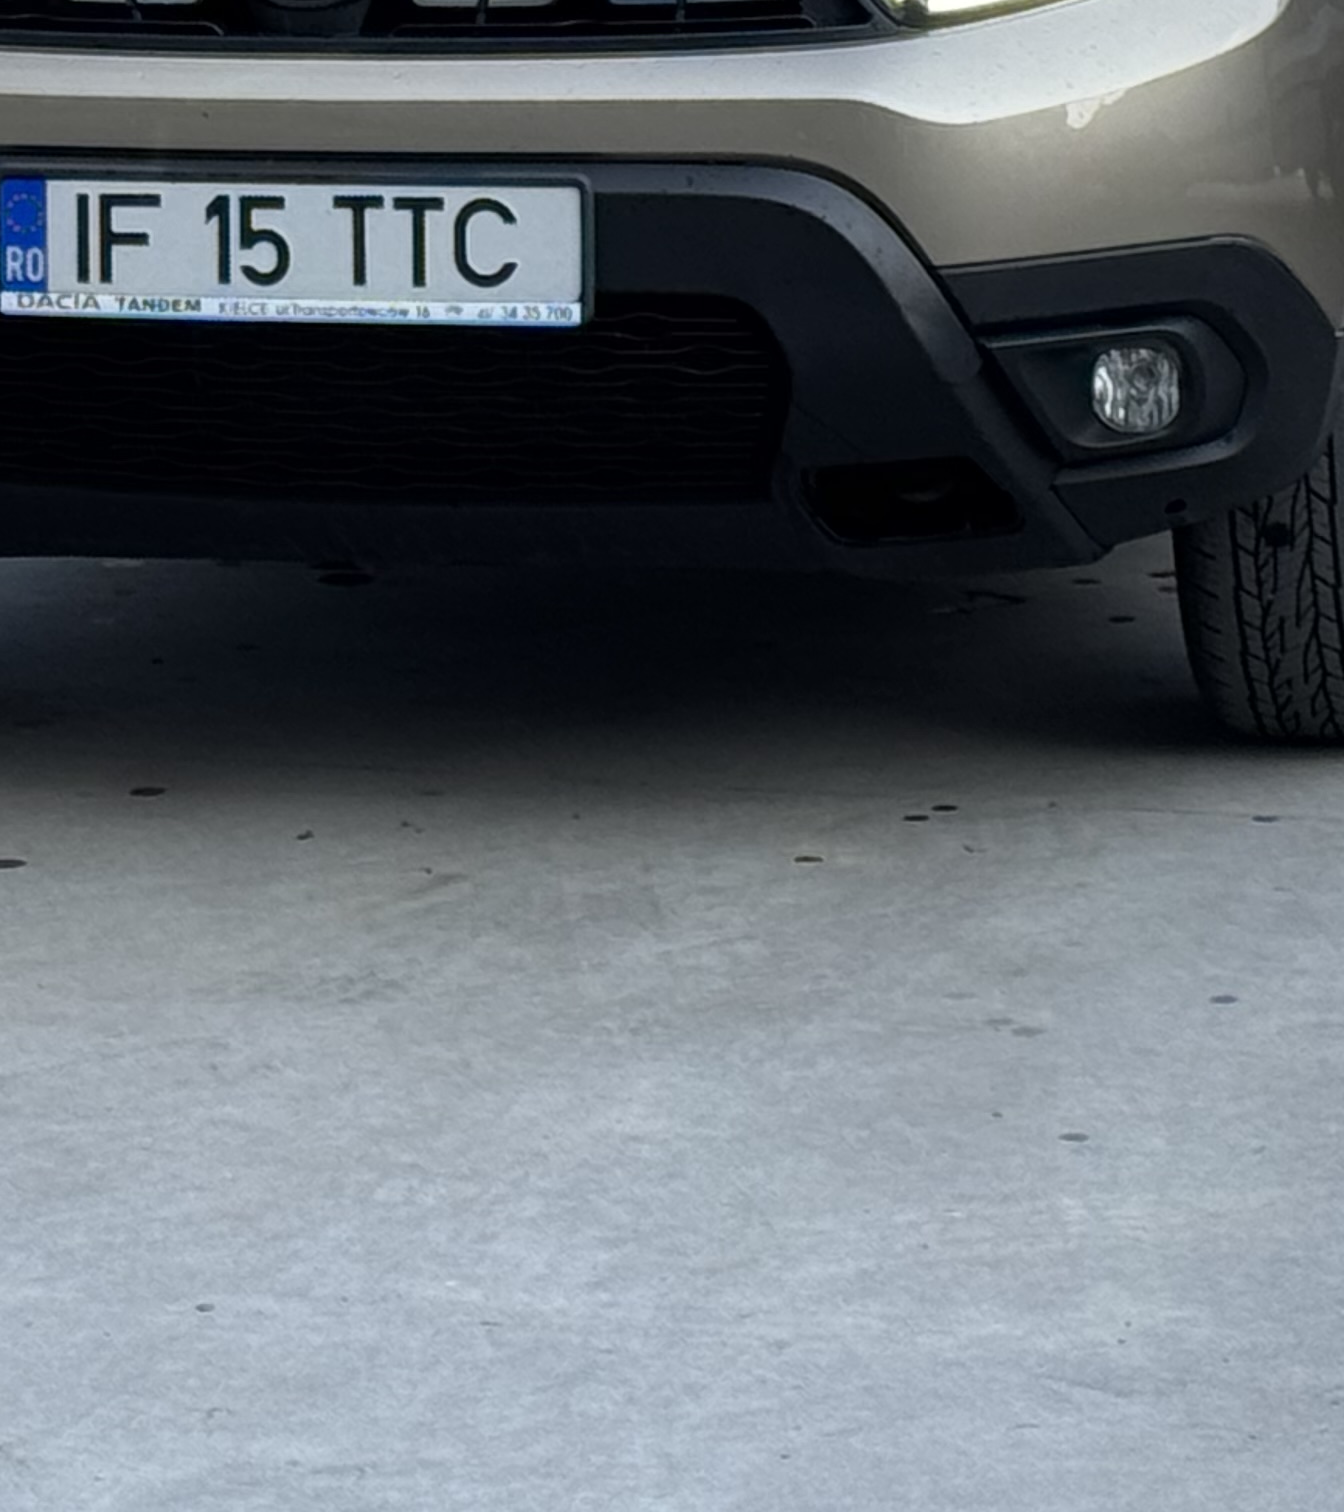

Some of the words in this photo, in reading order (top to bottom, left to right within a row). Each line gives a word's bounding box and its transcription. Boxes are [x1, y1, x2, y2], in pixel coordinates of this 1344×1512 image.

[75, 193, 162, 284] IF
[205, 194, 291, 286] 15
[332, 195, 519, 288] TTC
[6, 246, 44, 283] RO
[17, 294, 101, 310] DACIA
[115, 297, 202, 313] TANDEM
